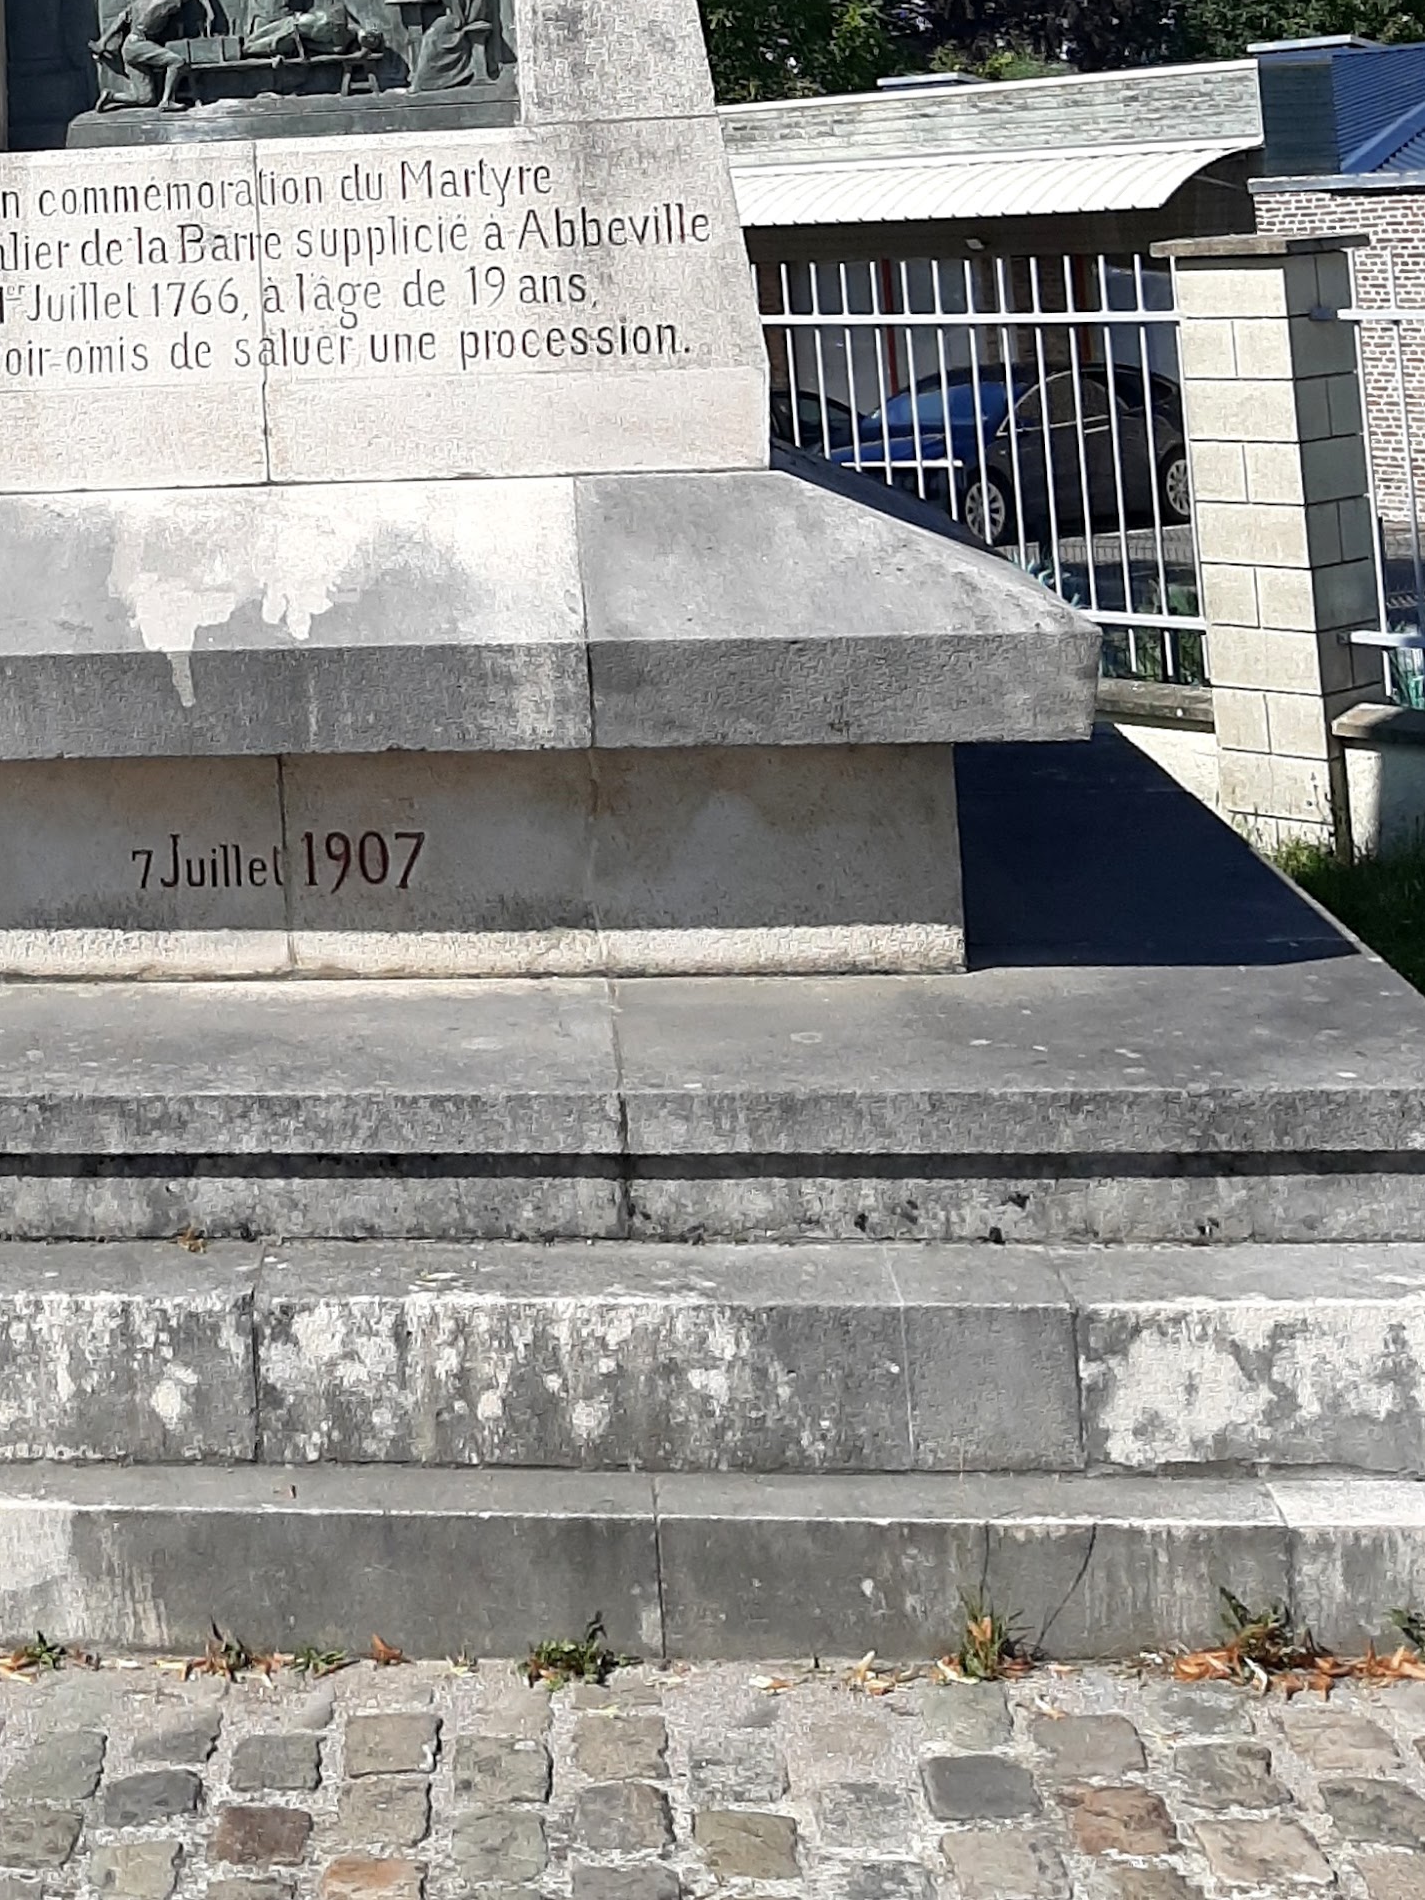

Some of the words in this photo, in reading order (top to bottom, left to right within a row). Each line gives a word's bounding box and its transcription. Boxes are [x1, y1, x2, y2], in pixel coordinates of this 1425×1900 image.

[38, 169, 323, 217] commémoration
[341, 164, 383, 201] du
[400, 158, 553, 207] Martyre
[80, 229, 124, 267] de
[136, 227, 167, 264] la
[177, 224, 283, 264] Barre
[295, 215, 468, 267] supplicié
[484, 215, 506, 251] à
[518, 203, 712, 250] Abbeville
[26, 282, 139, 322] Juillet
[152, 277, 250, 322] 1766,
[263, 276, 285, 314] à
[403, 268, 446, 308] de
[468, 266, 506, 307] 19
[518, 272, 598, 308] ans,
[67, 340, 149, 374] omis
[170, 331, 212, 370] de
[234, 328, 352, 367] saluer
[370, 331, 436, 363] une
[459, 316, 692, 371] procession.
[131, 849, 153, 889] 7
[160, 834, 284, 888] Juillet
[301, 831, 425, 894] 1907
